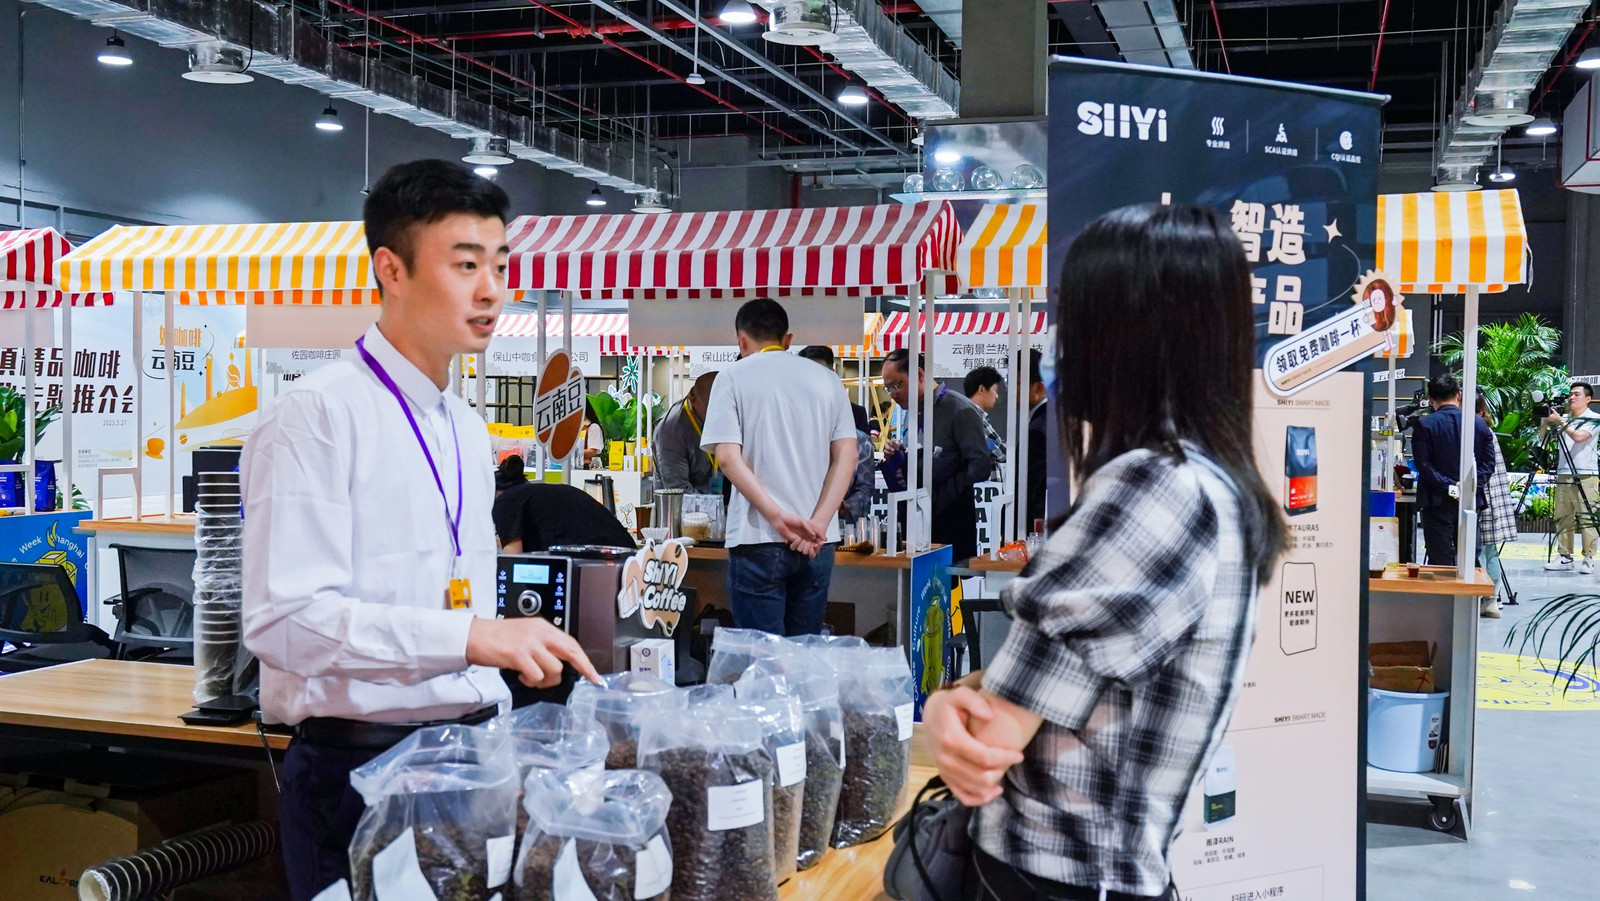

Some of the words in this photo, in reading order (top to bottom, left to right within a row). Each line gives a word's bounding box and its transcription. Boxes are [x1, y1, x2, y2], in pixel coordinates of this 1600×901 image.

[292, 350, 341, 360] 佐园咖啡庄园
[1276, 318, 1361, 374] 领取免费咖啡一杯
[536, 377, 582, 433] 云南豆
[19, 535, 42, 554] Week
[643, 584, 687, 613] Coffee
[1285, 590, 1315, 604] NEW
